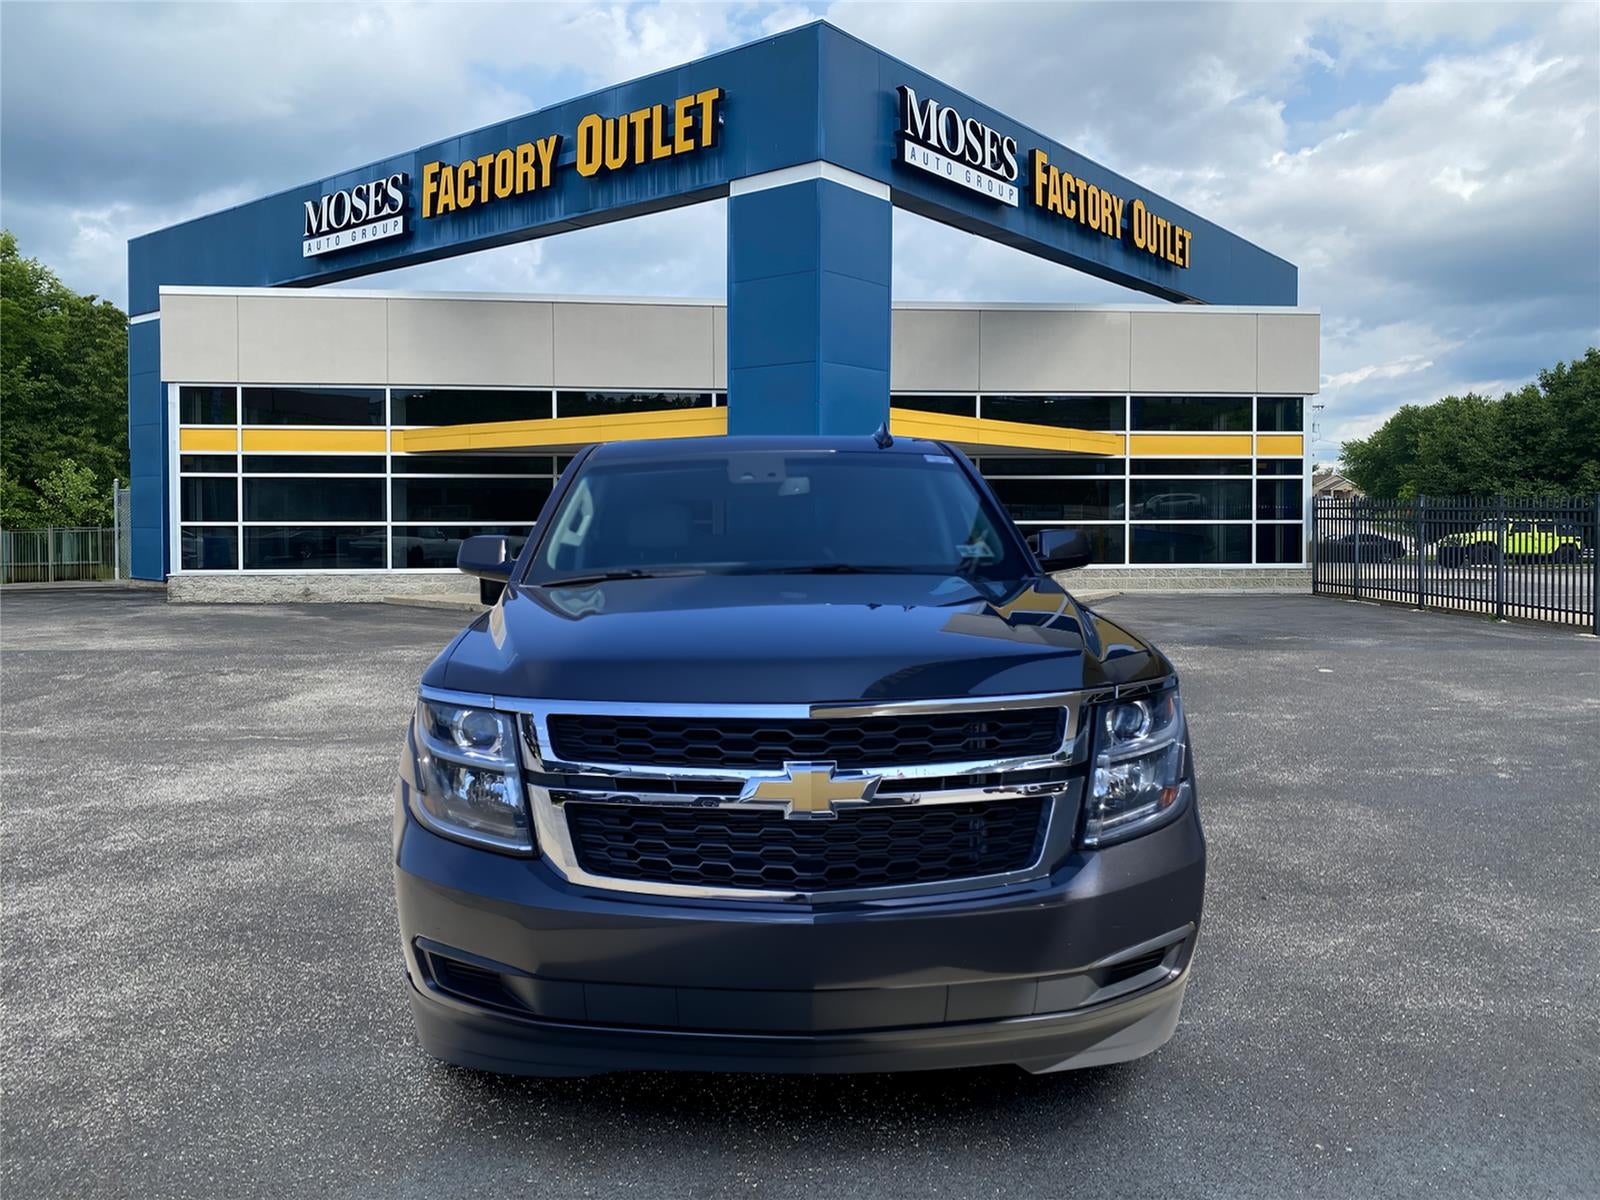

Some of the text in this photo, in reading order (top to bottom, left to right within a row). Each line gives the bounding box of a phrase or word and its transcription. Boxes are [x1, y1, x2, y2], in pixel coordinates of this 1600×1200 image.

[422, 88, 720, 218] FACTORY OUTLET
[904, 85, 1018, 181] MOSES
[303, 174, 403, 236] MOSES
[910, 147, 1015, 201] AUTO GROUP
[1035, 149, 1192, 268] FACTORY OUTLET
[307, 220, 399, 254] AUTO GROUP
